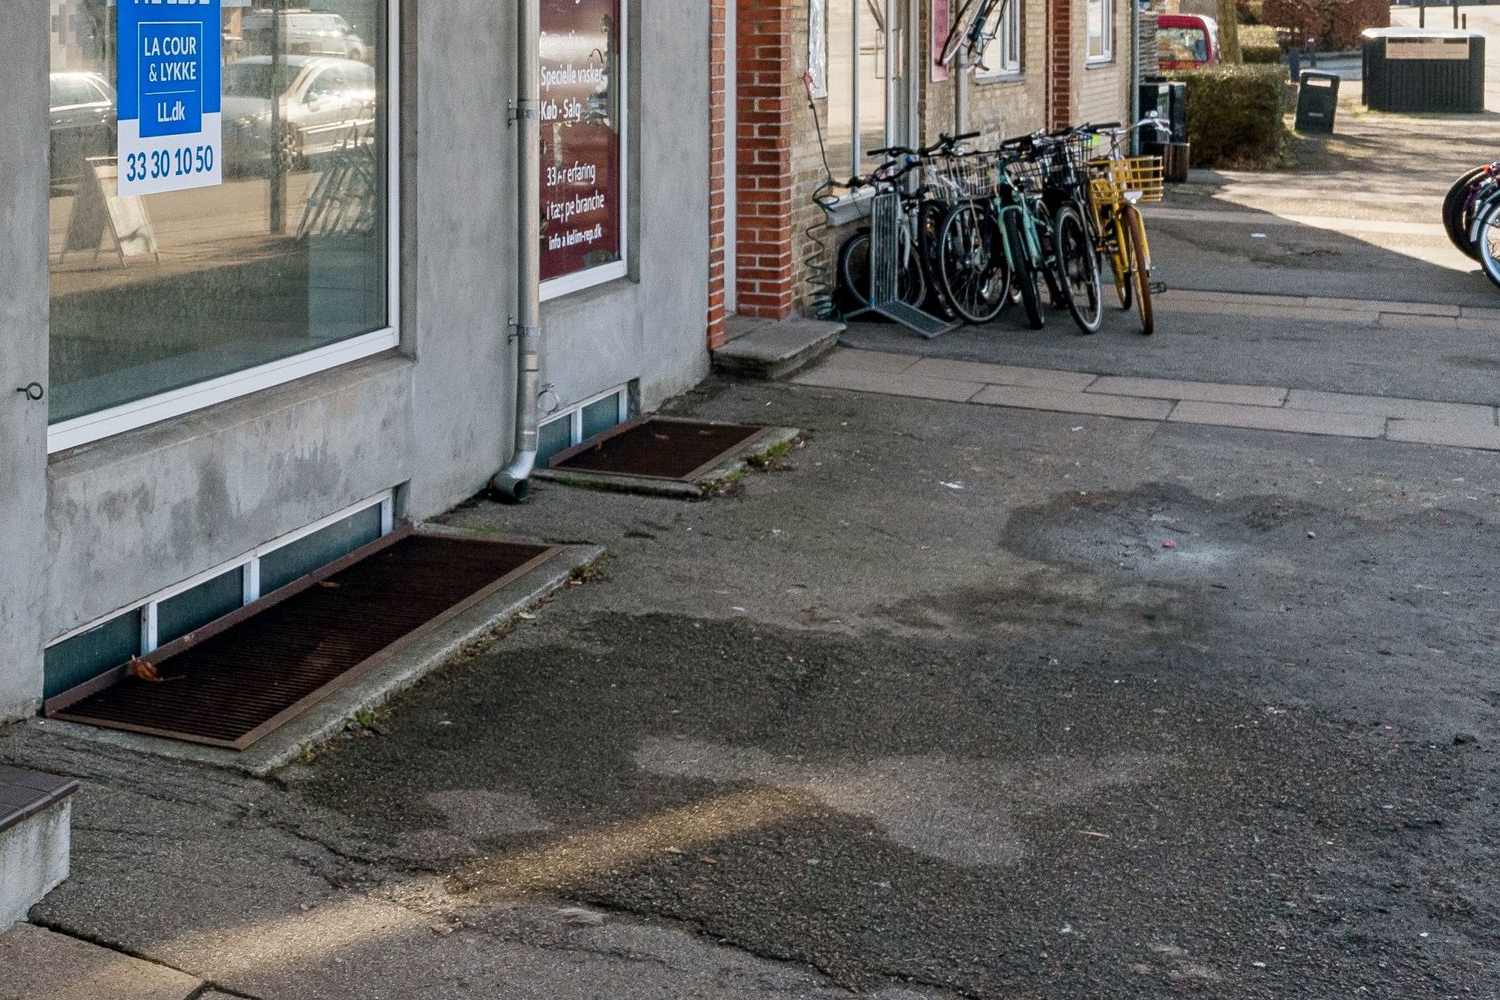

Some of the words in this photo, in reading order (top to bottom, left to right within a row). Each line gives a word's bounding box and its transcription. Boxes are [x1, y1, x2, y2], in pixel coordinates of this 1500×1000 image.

[144, 37, 160, 56] LA
[163, 36, 196, 56] COUR
[149, 63, 157, 82] &
[160, 61, 197, 82] LYKKE
[541, 64, 576, 92] Specielle
[158, 101, 185, 123] LL.dk
[541, 98, 557, 121] Køb
[563, 97, 581, 123] Salg
[126, 151, 147, 182] 33
[151, 149, 170, 179] 30
[175, 147, 192, 176] 10
[195, 144, 213, 173] 50
[546, 166, 556, 187] 33
[567, 160, 596, 185] erfaring
[575, 190, 605, 214] branche
